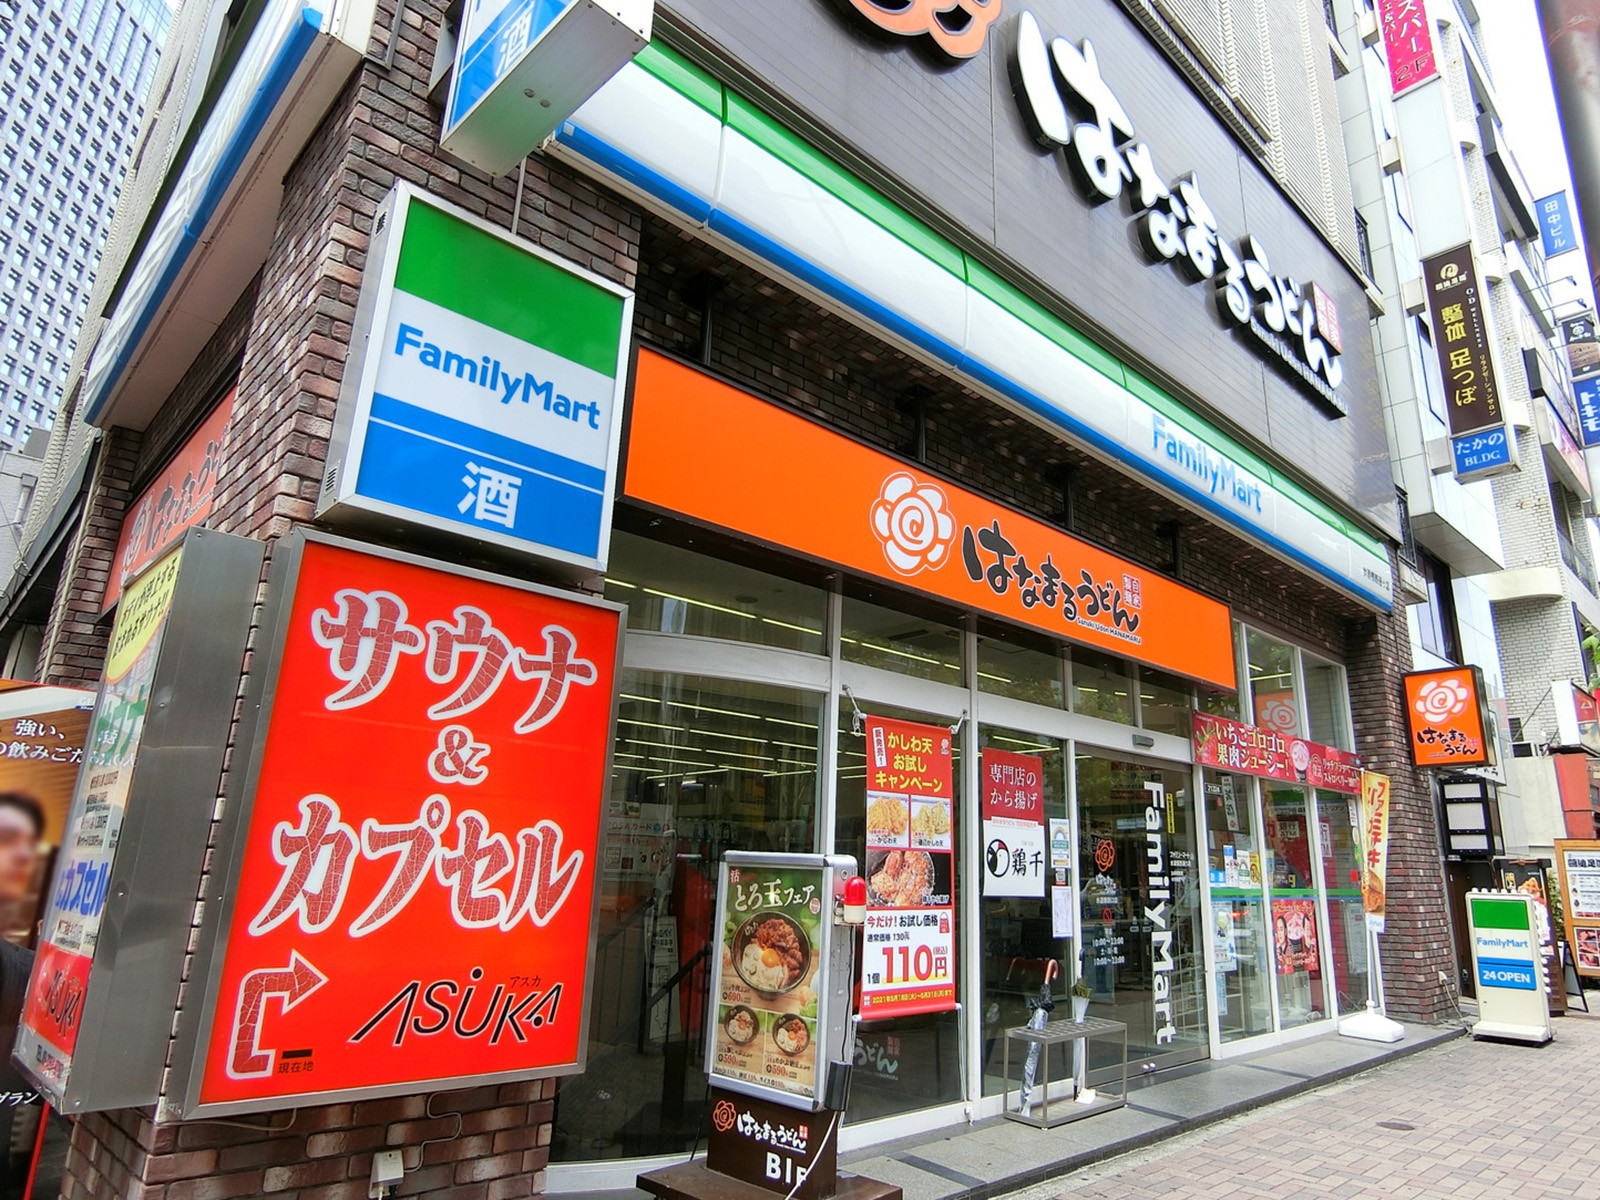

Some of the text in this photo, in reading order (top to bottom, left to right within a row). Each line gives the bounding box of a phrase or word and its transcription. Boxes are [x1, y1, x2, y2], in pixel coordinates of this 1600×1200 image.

[495, 1, 535, 78] 酒
[1396, 52, 1429, 83] 2F
[1016, 9, 1344, 390] はなまるうどん
[1544, 200, 1566, 249] 田中ビル
[1441, 303, 1467, 342] 整体
[394, 322, 600, 432] FamilyMart
[1450, 347, 1477, 407] 足つぼ
[1456, 432, 1504, 456] たかの
[1464, 450, 1500, 467] BLDG
[1152, 411, 1262, 514] FamilyMart
[456, 461, 523, 529] 酒
[961, 519, 1140, 633] はなまるうどん
[311, 588, 597, 734] サウナ
[887, 732, 933, 755] かしわ天
[1416, 726, 1467, 745] はなまる
[1444, 743, 1477, 756] うどん
[428, 725, 491, 785] &
[893, 753, 927, 773] お試し
[1216, 742, 1290, 776] 果肉ジューシー!
[875, 770, 942, 793] キャンペーン
[989, 764, 1037, 787] 専門店の
[990, 788, 1037, 810] から揚げ
[1367, 781, 1386, 868] ファミチキ
[249, 794, 584, 937] カプセル
[1011, 848, 1044, 877] 鶏千
[735, 879, 815, 912] とろ玉フェア
[866, 914, 938, 928] 今だけ! お試し価格
[1143, 781, 1177, 1046] FamilyMart
[1476, 936, 1529, 949] FamilyMart
[867, 944, 947, 984] 1個 110 円
[1483, 970, 1531, 984] 24 OPEN
[509, 974, 541, 989] アスカ
[347, 967, 565, 1047] ASUKA
[277, 1061, 314, 1074] 現在地
[737, 1111, 807, 1150] はなまるうどん
